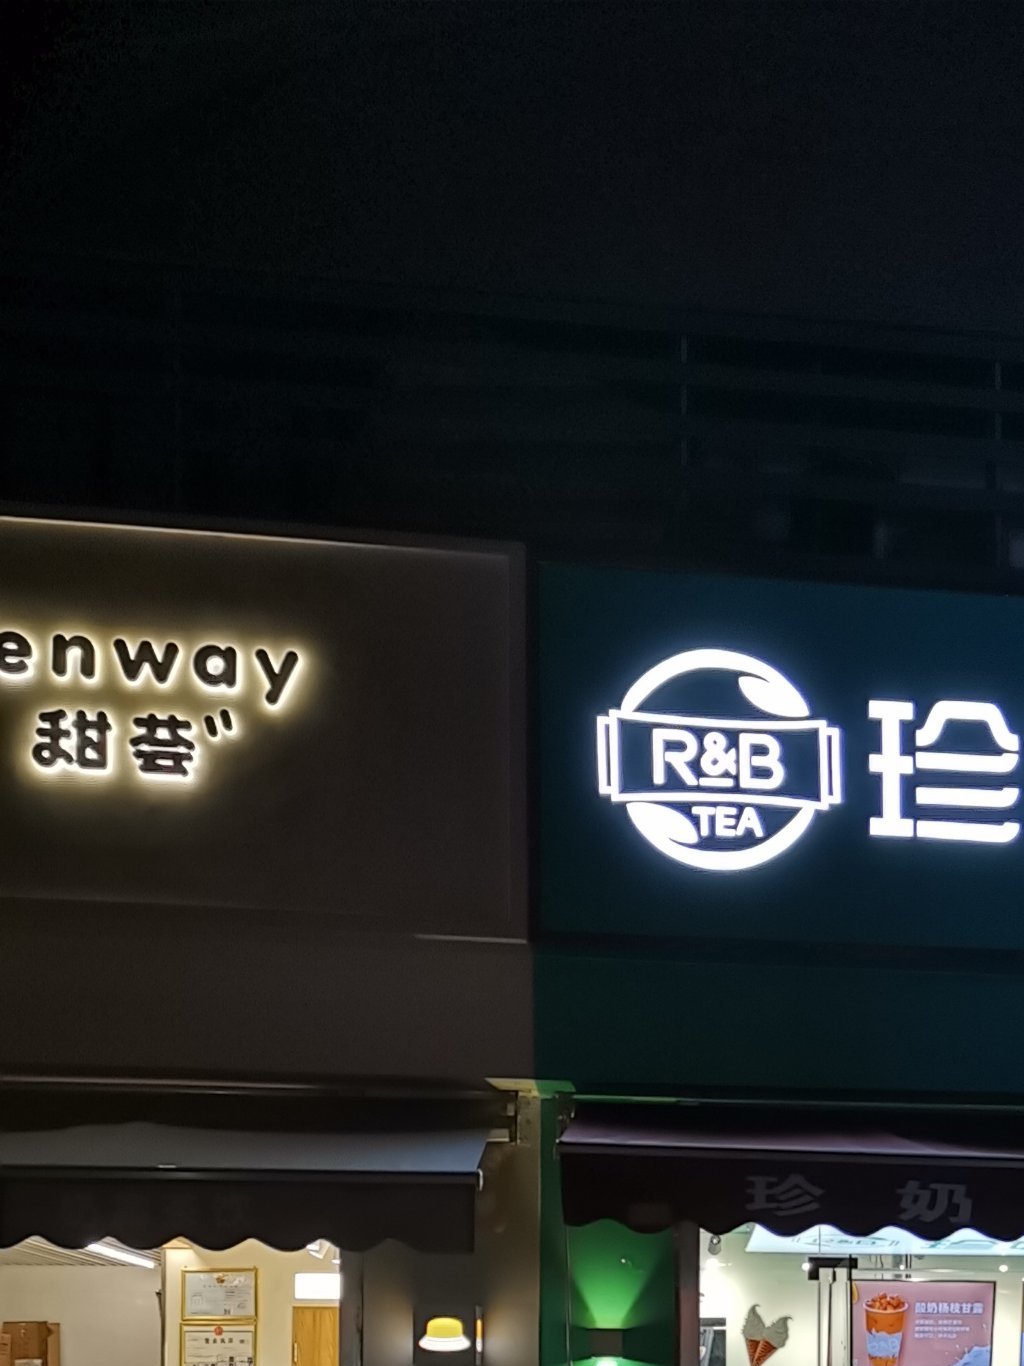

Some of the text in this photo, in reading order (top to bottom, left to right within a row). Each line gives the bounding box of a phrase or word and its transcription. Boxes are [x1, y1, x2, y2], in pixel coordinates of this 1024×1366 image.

[0, 631, 299, 705] enway
[32, 708, 196, 778] 甜荟
[652, 727, 785, 791] R&B
[690, 803, 764, 840] TEA
